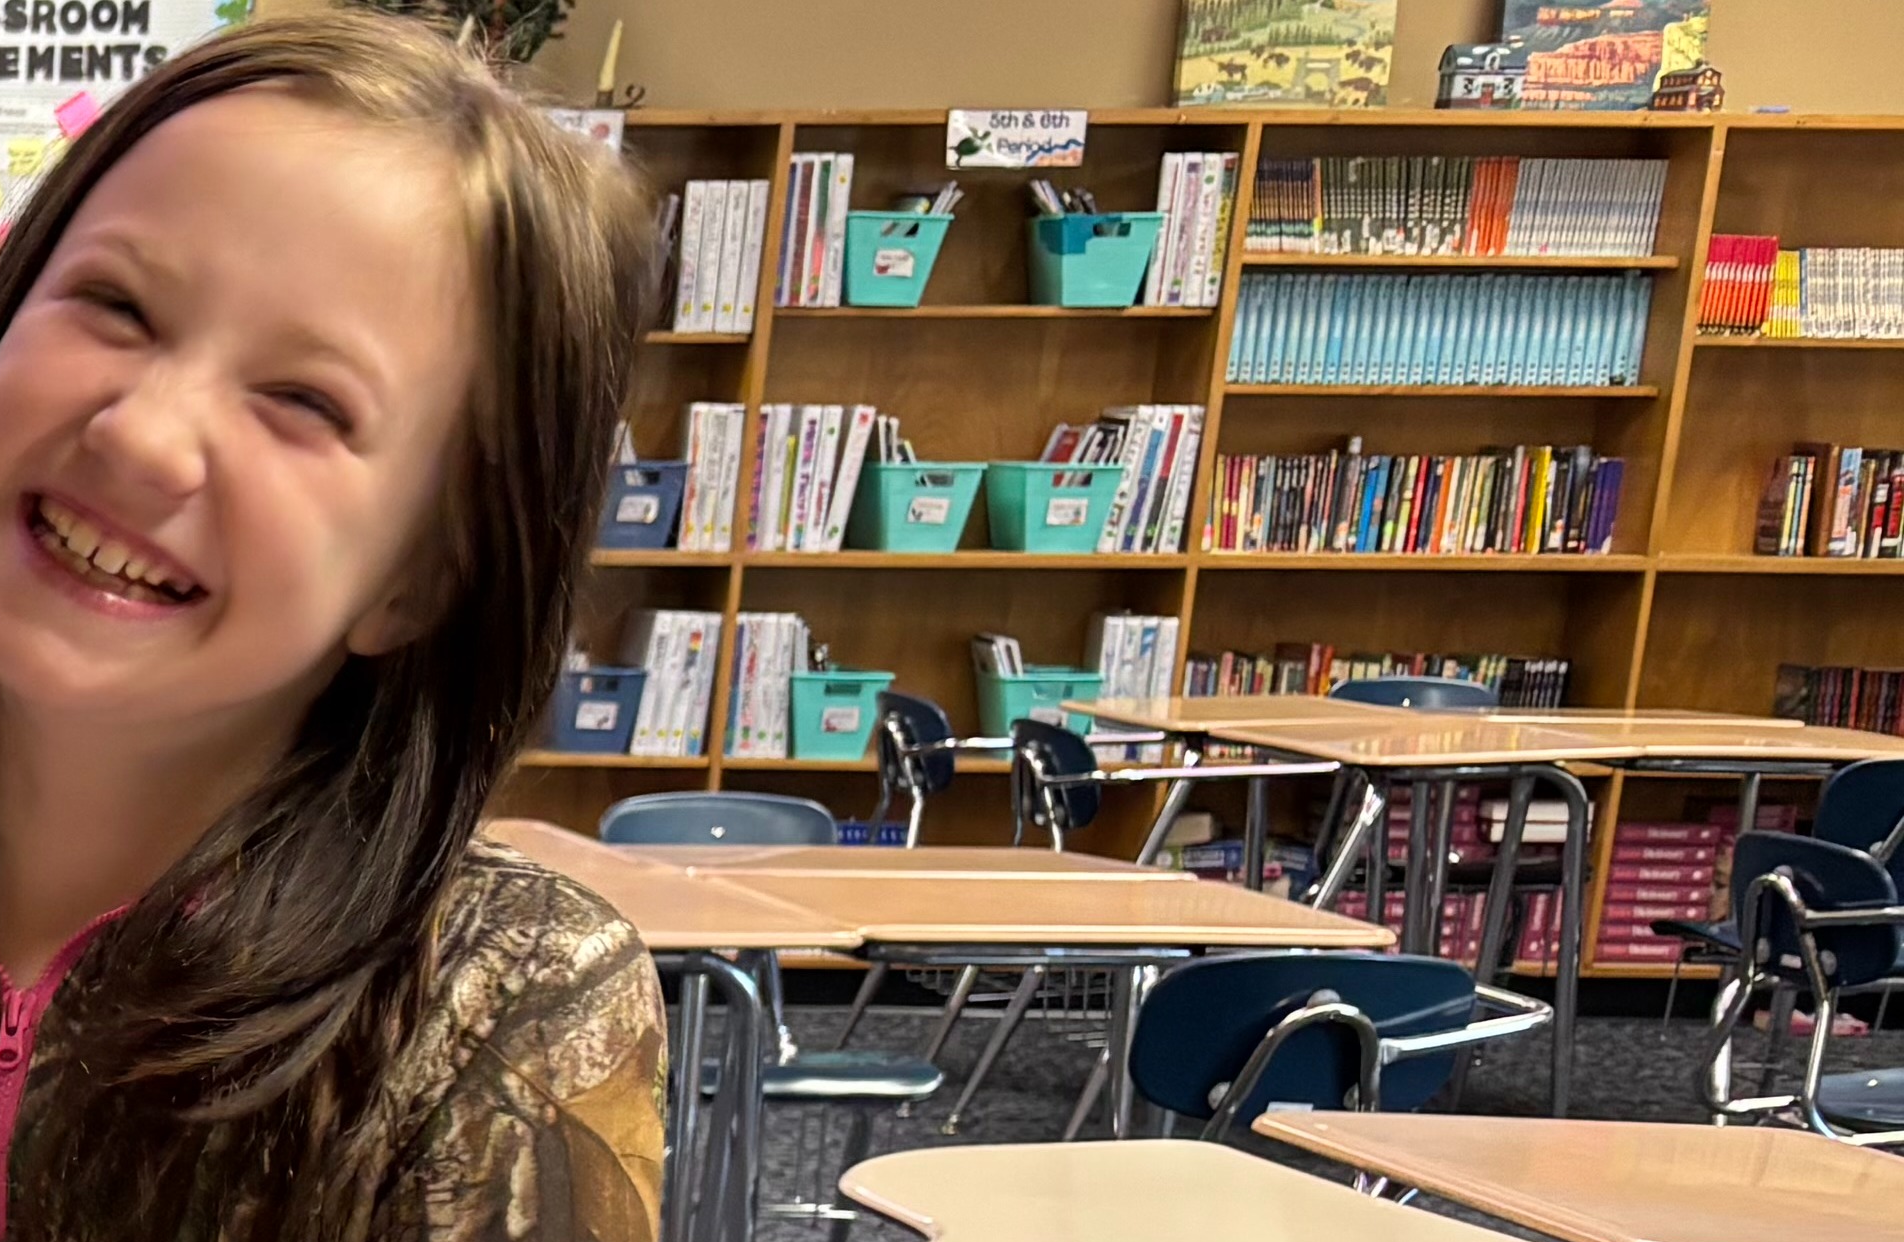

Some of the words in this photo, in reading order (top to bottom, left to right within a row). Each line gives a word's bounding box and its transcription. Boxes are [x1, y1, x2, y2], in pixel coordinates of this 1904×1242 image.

[989, 112, 1019, 129] 5th
[1021, 112, 1036, 129] &
[996, 136, 1053, 154] Period
